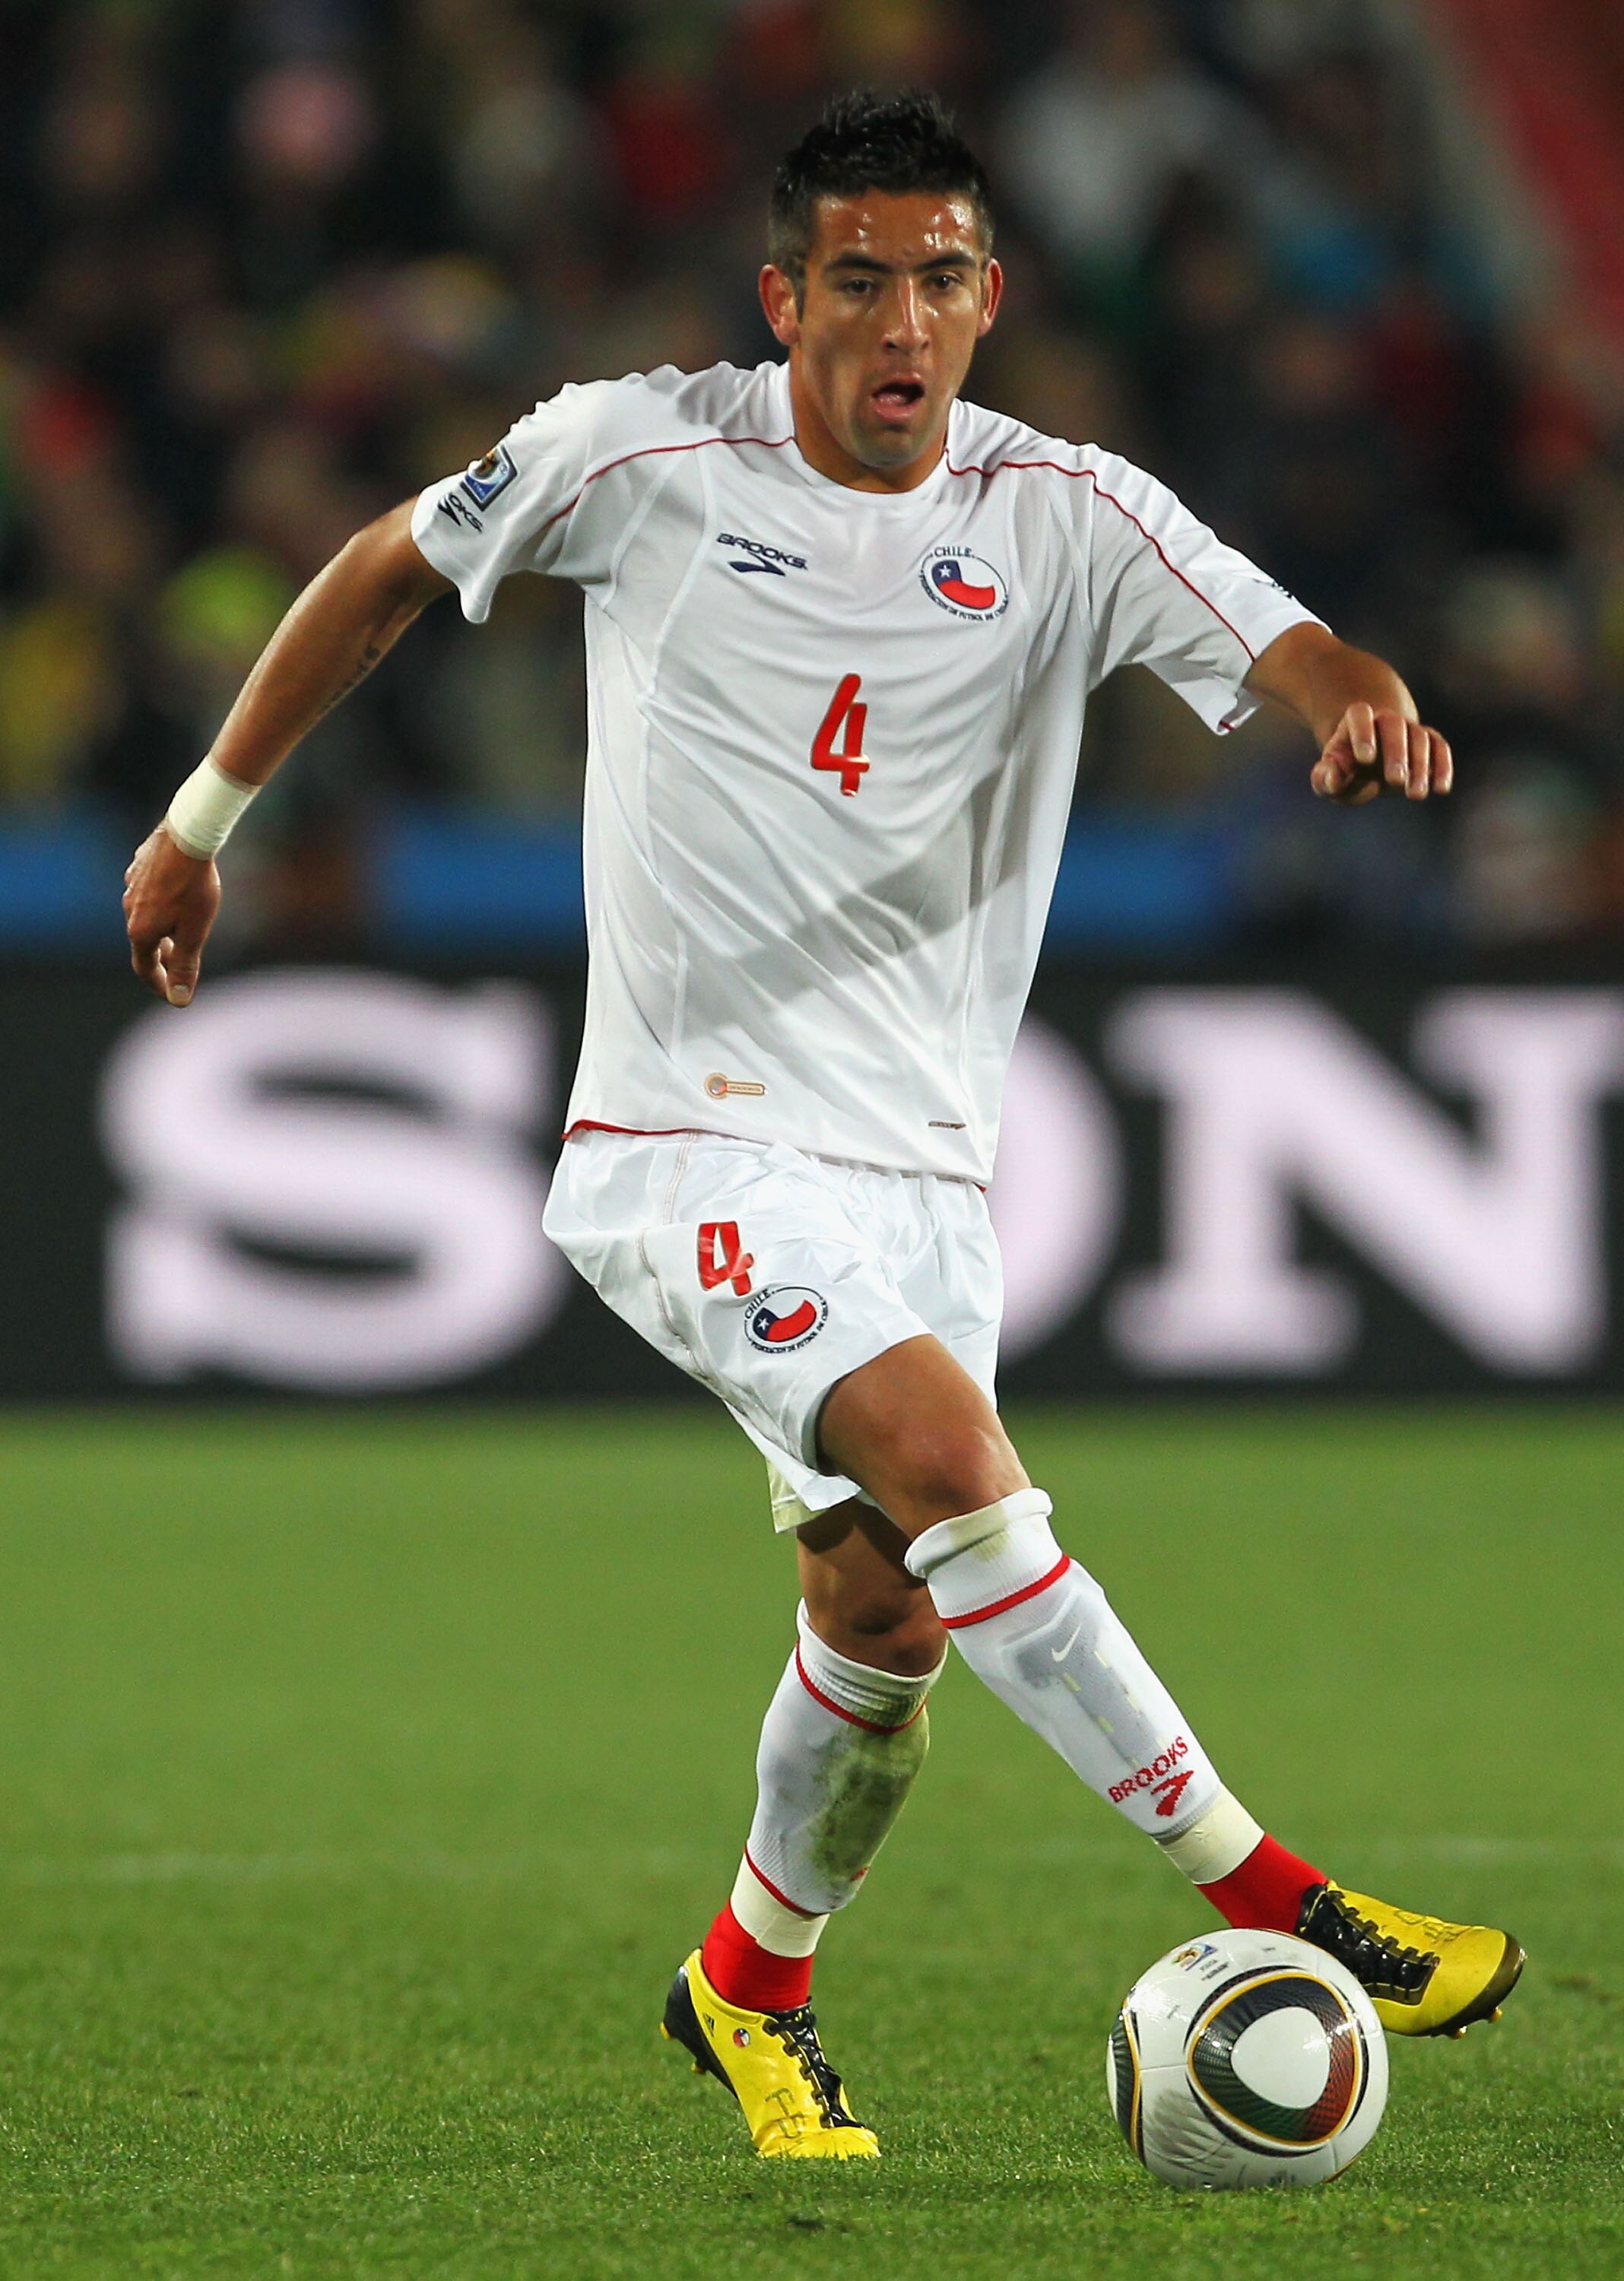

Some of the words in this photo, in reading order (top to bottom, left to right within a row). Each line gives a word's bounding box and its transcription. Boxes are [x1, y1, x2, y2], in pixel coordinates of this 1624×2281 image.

[717, 533, 807, 569] BROOKS
[934, 547, 972, 557] CHILE
[810, 673, 870, 796] 4
[100, 972, 1624, 1391] SN
[698, 1220, 754, 1296] 4
[744, 1289, 771, 1319] CHILE
[1108, 1736, 1188, 1804] BROOKS
